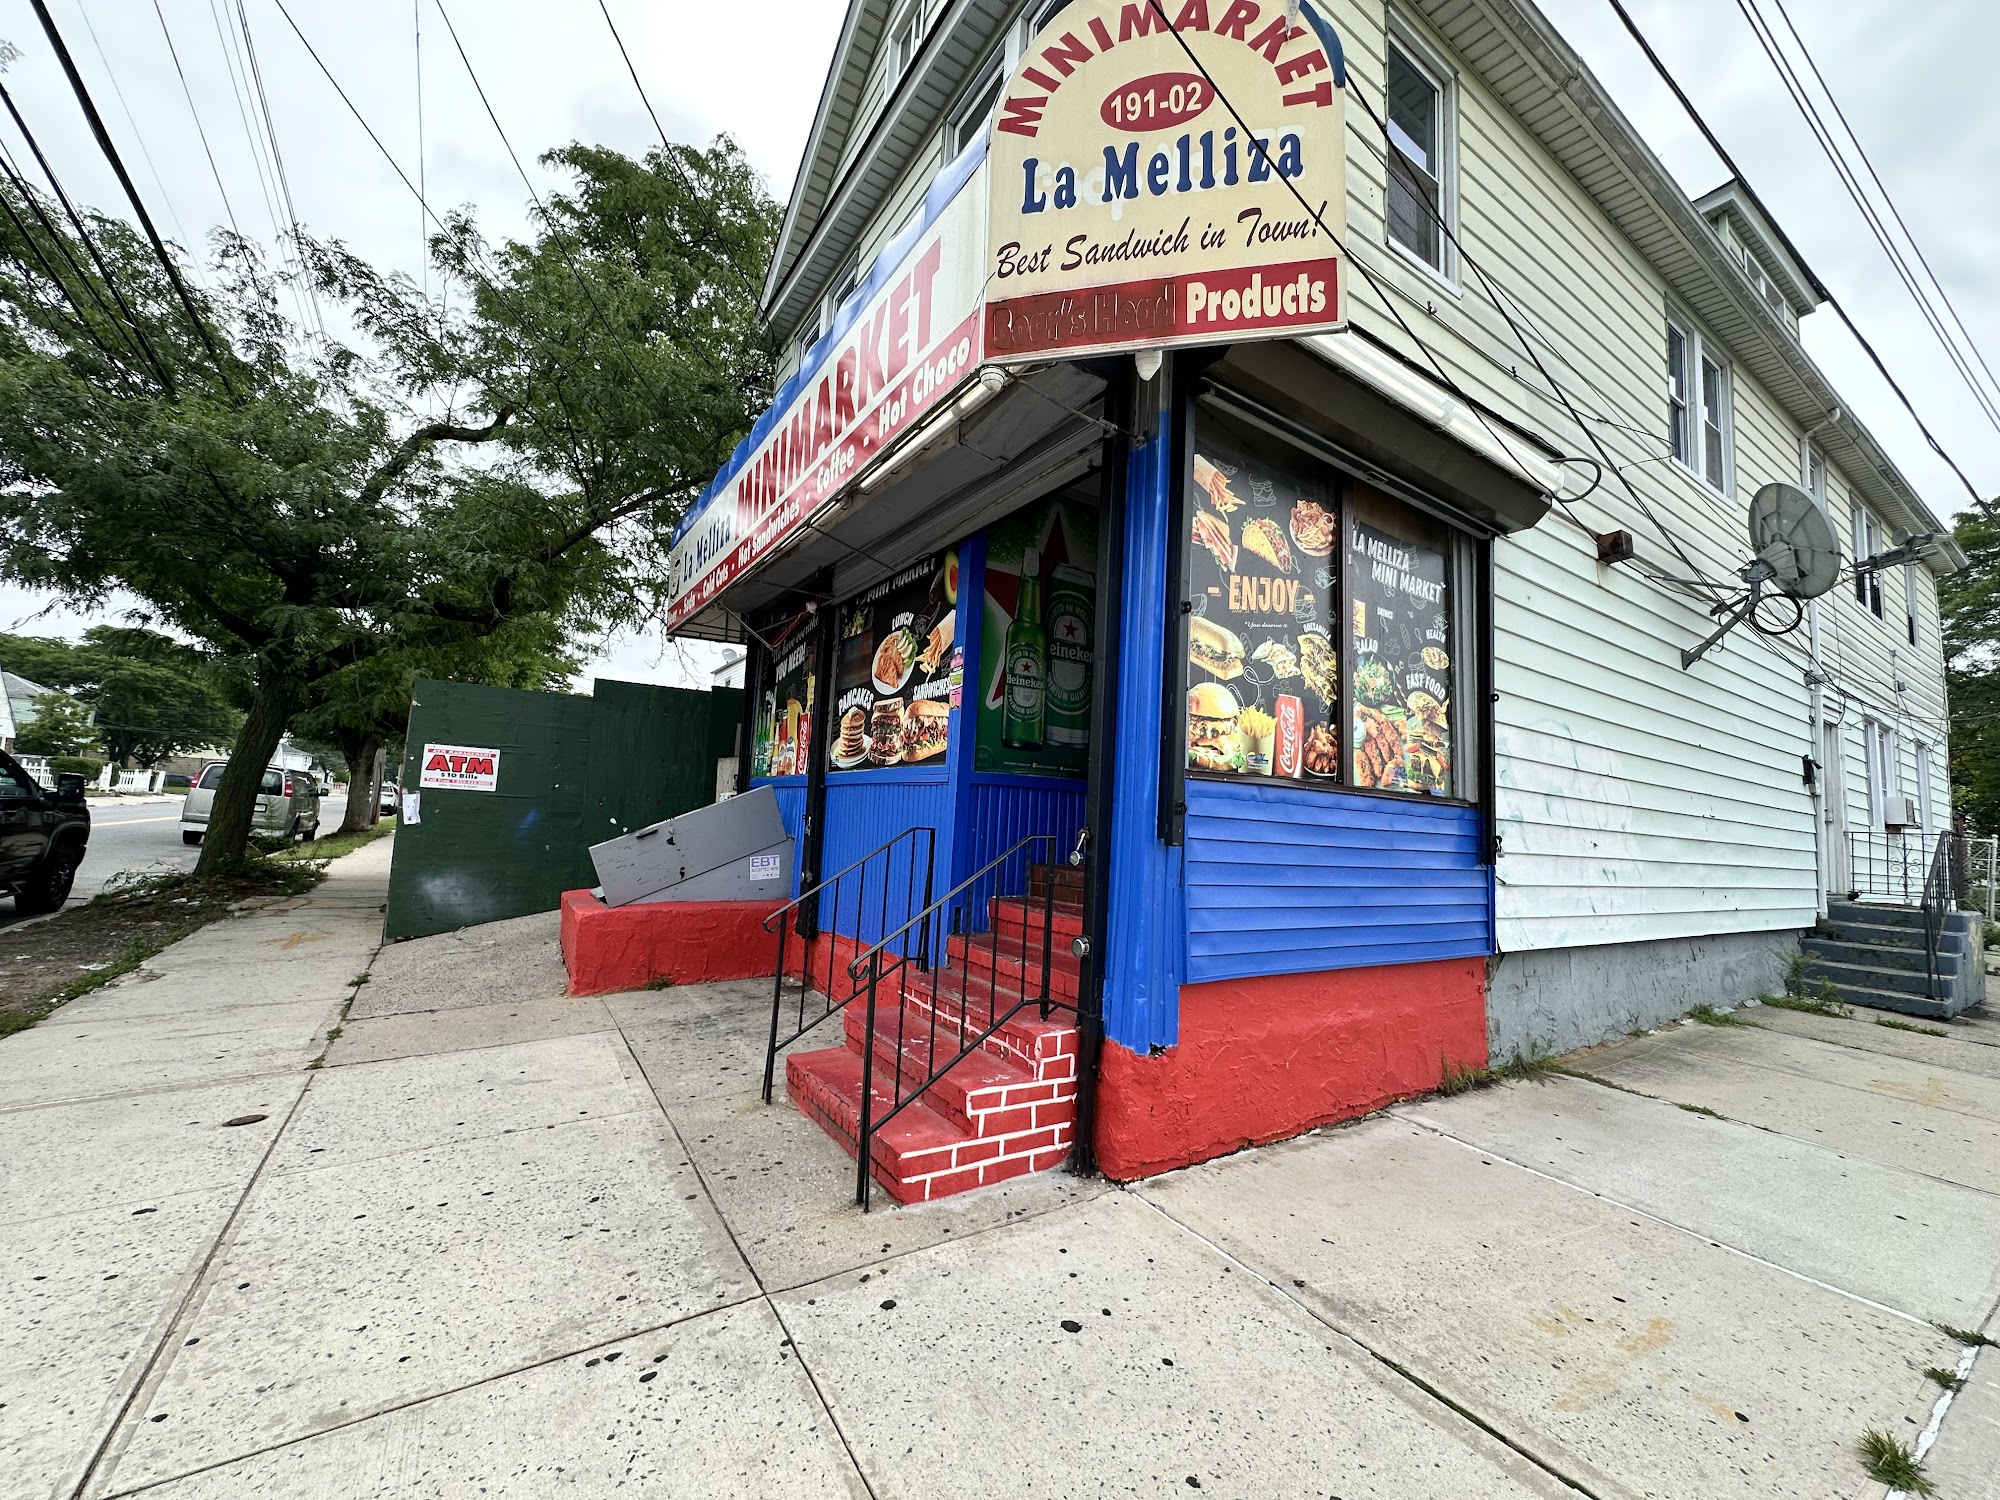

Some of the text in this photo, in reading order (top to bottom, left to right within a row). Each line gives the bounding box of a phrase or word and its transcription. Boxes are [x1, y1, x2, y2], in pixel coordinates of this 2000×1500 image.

[997, 0, 1334, 138] MINIMARKET
[1109, 81, 1203, 124] 191-02
[1020, 126, 1304, 215] La Melliza
[996, 200, 1329, 280] Best Sandwich in Town!
[1185, 272, 1327, 325] Products
[683, 550, 693, 583] La
[734, 235, 942, 543] MINIMARKET
[702, 573, 716, 599] Cold
[737, 541, 751, 569] Hot
[751, 501, 800, 558] Sandwiches
[815, 442, 856, 497] Coffee
[877, 396, 908, 439] Hot
[911, 334, 972, 398] Choco
[1352, 529, 1410, 574] LA MELLIZA
[1228, 575, 1300, 614] ENJOY
[1371, 560, 1443, 604] MINI MARKET
[891, 611, 915, 631] LUNCH
[1425, 628, 1447, 645] HEALTH
[1355, 638, 1379, 655] SALAD
[838, 687, 875, 717] PANCAKES
[1006, 673, 1045, 691] Heineken
[1405, 672, 1447, 701] FAST FOOD
[426, 755, 493, 775] ATM
[751, 856, 780, 868] EBT
